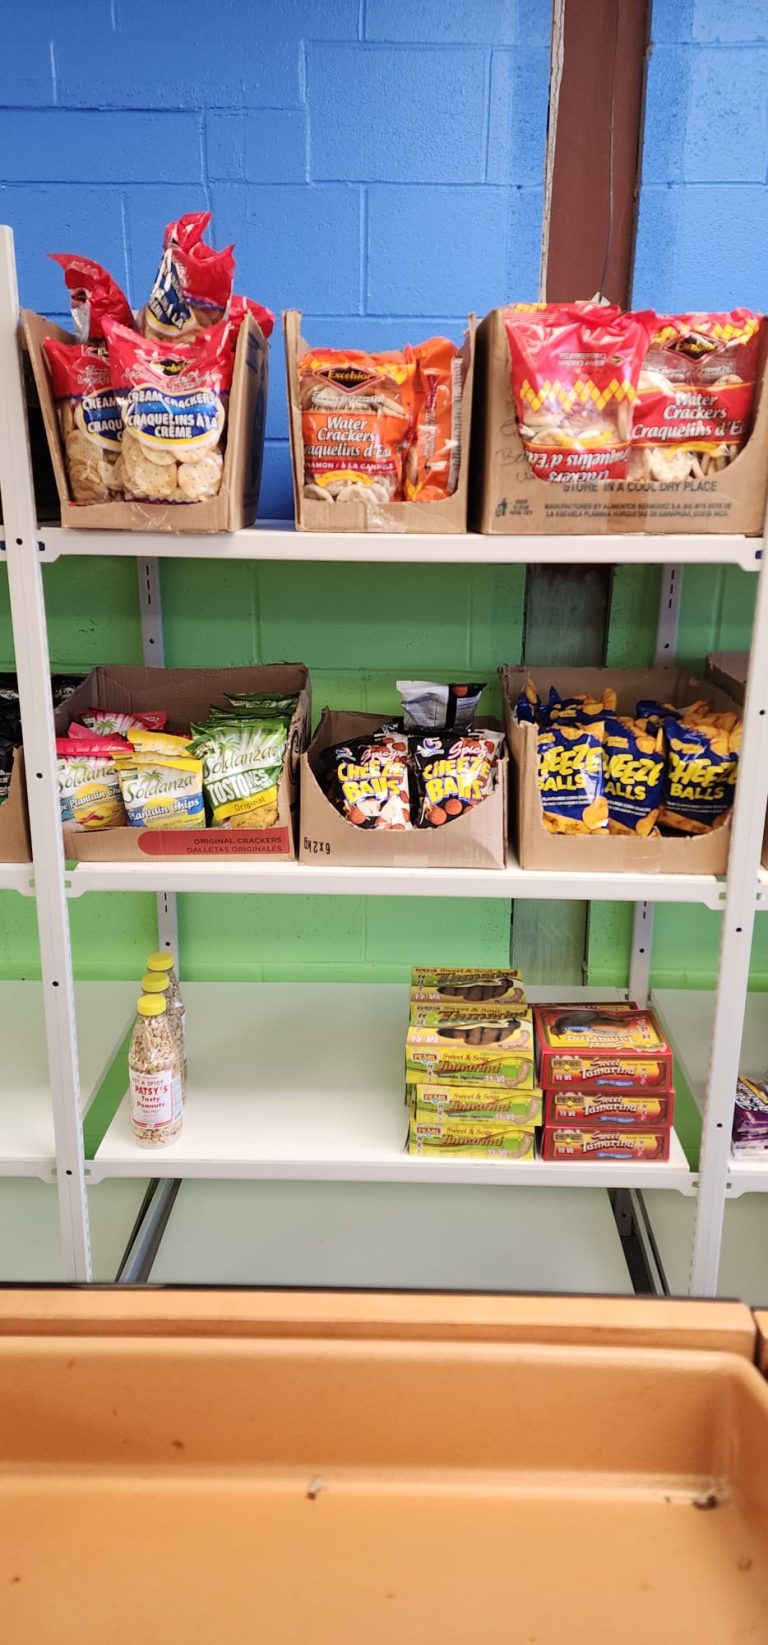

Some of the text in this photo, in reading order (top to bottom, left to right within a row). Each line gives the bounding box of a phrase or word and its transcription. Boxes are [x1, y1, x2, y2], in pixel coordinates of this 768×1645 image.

[164, 392, 217, 409] CRACKERS
[674, 391, 719, 406] Water
[663, 404, 728, 420] Crackers
[87, 418, 123, 433] CRAQU
[127, 414, 194, 427] CRAQUELINS
[327, 416, 368, 429] Water
[317, 427, 376, 442] Crackers
[631, 421, 712, 440] Craquelins
[563, 480, 717, 493] STORE IN A COOL DRY PLACE
[360, 749, 397, 766] Spicy
[447, 741, 488, 760] Spicy
[203, 746, 272, 779] Soldanza
[538, 744, 603, 776] HEEZE
[337, 759, 404, 782] CHEEZE
[422, 756, 491, 780] CHEEZE
[58, 766, 118, 793] Soldanz
[124, 776, 193, 804] Soldanza
[342, 777, 400, 805] BALLS
[425, 776, 484, 804] BALLS
[604, 781, 647, 801] ALLS
[670, 782, 725, 801] BALLS
[70, 789, 107, 809] Plantain
[234, 796, 266, 812] Original
[127, 806, 170, 821] Plantain
[171, 798, 200, 813] Chips
[237, 836, 282, 844] CRACKERS
[443, 1051, 464, 1060] Sweet
[473, 1054, 490, 1062] Sour
[590, 1057, 621, 1068] Sweet
[439, 1060, 502, 1074] Tamarind
[580, 1064, 637, 1079] Tamarind
[135, 1085, 168, 1095] PATSY'S
[453, 1092, 475, 1101] Sweet
[476, 1093, 482, 1101] &
[484, 1094, 500, 1102] Sour
[137, 1101, 165, 1109] Peanuts
[449, 1100, 512, 1113] Tamarind
[593, 1093, 623, 1105] Sweet
[584, 1101, 638, 1116] Tamarind
[446, 1125, 467, 1135] Sweet
[468, 1127, 474, 1135] &
[476, 1128, 493, 1136] Sour
[590, 1130, 621, 1141] Sweet
[442, 1133, 504, 1147] Tamarind
[581, 1138, 635, 1153] Tamarind
